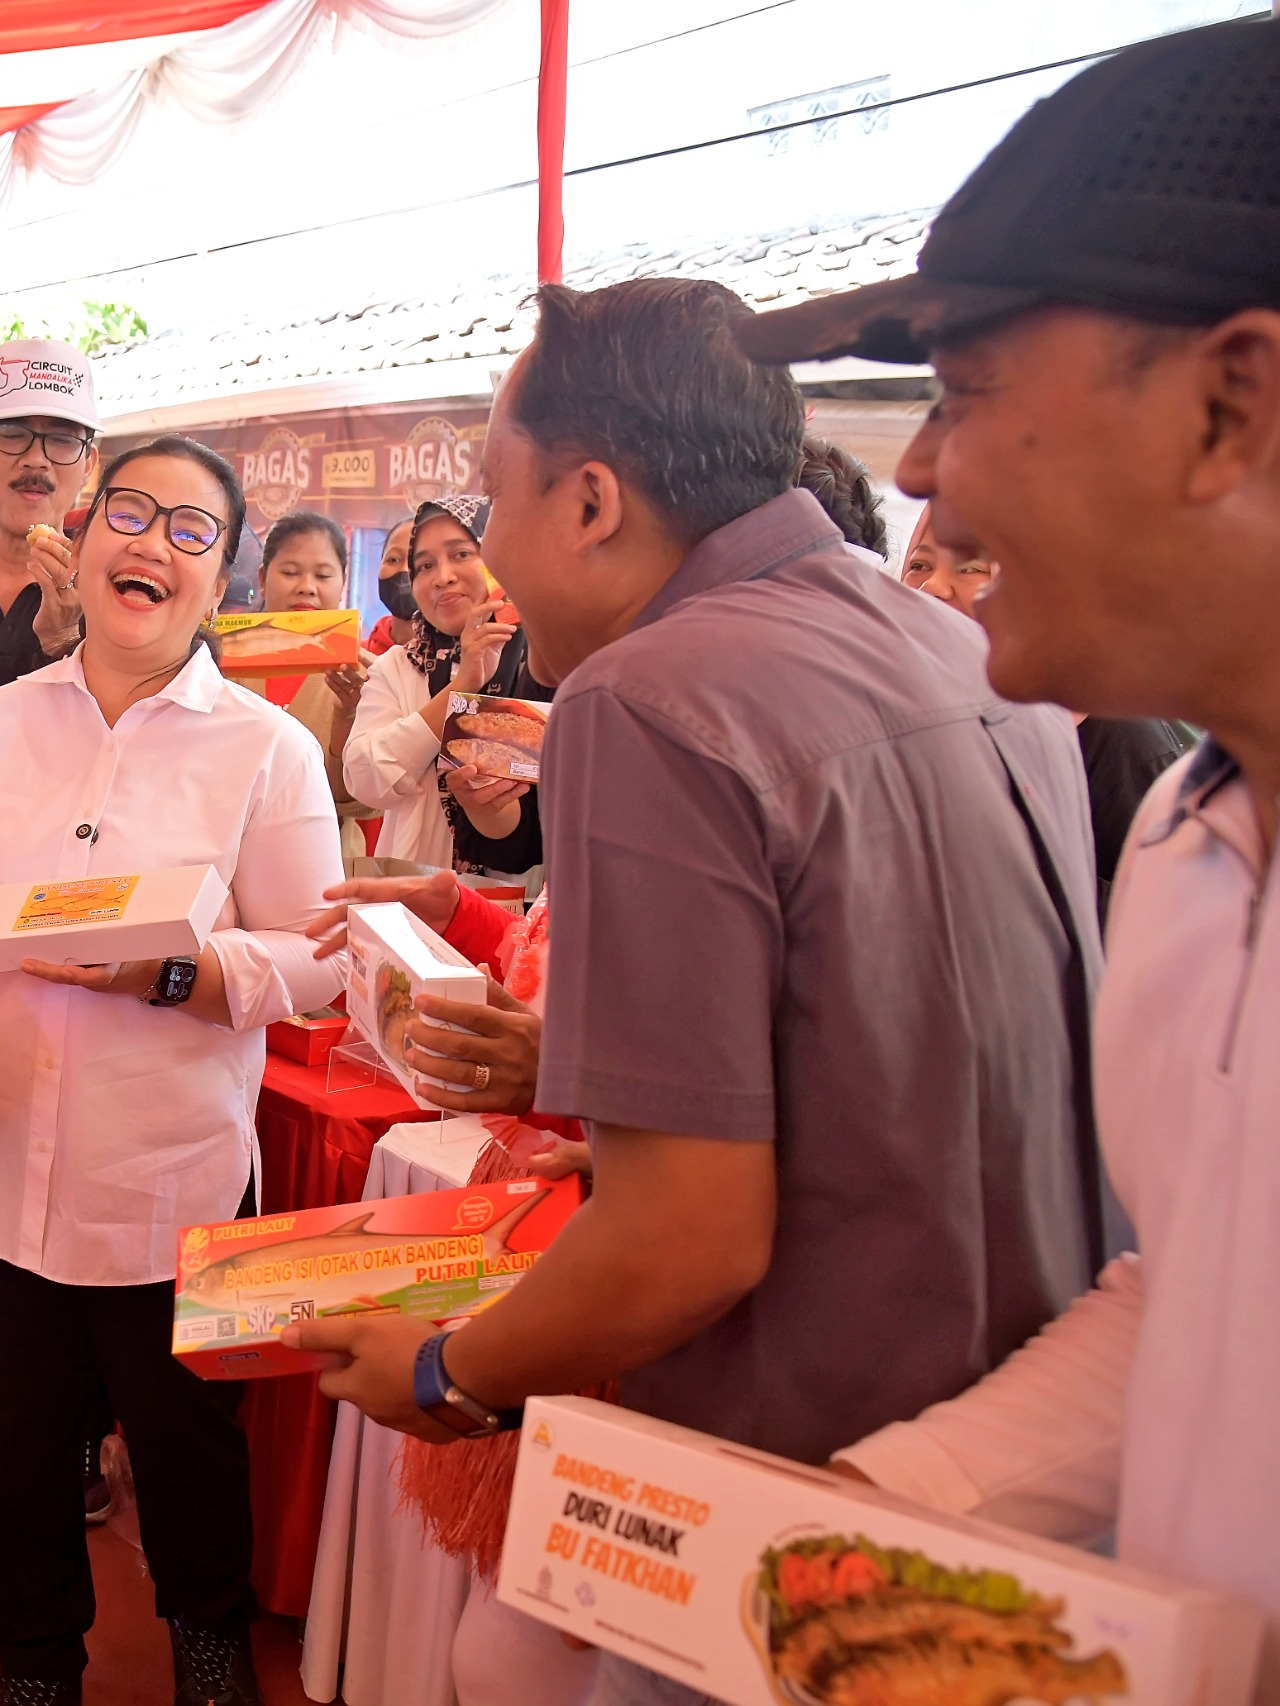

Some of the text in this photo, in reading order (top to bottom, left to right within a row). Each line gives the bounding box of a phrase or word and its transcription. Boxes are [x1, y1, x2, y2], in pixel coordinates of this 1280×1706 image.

[29, 373, 72, 384] MANDALIKA
[31, 361, 72, 375] CIRCUIT
[29, 382, 74, 396] LOMBOK
[243, 448, 309, 490] BAGAS
[389, 441, 470, 489] BAGAS
[214, 1217, 296, 1241] PUTRI LAUT
[225, 1235, 484, 1290] BANDENG ISI (OTAK OTAK BANDENG)
[416, 1262, 477, 1283] PUTRI
[485, 1252, 539, 1274] LAUT
[248, 1305, 275, 1334] SKP
[291, 1303, 315, 1322] SNI
[553, 1454, 712, 1527] BANDENG PRESTO
[563, 1492, 685, 1556] DURI LUNAK
[545, 1522, 580, 1560] BU
[581, 1536, 697, 1606] FATKHAN
